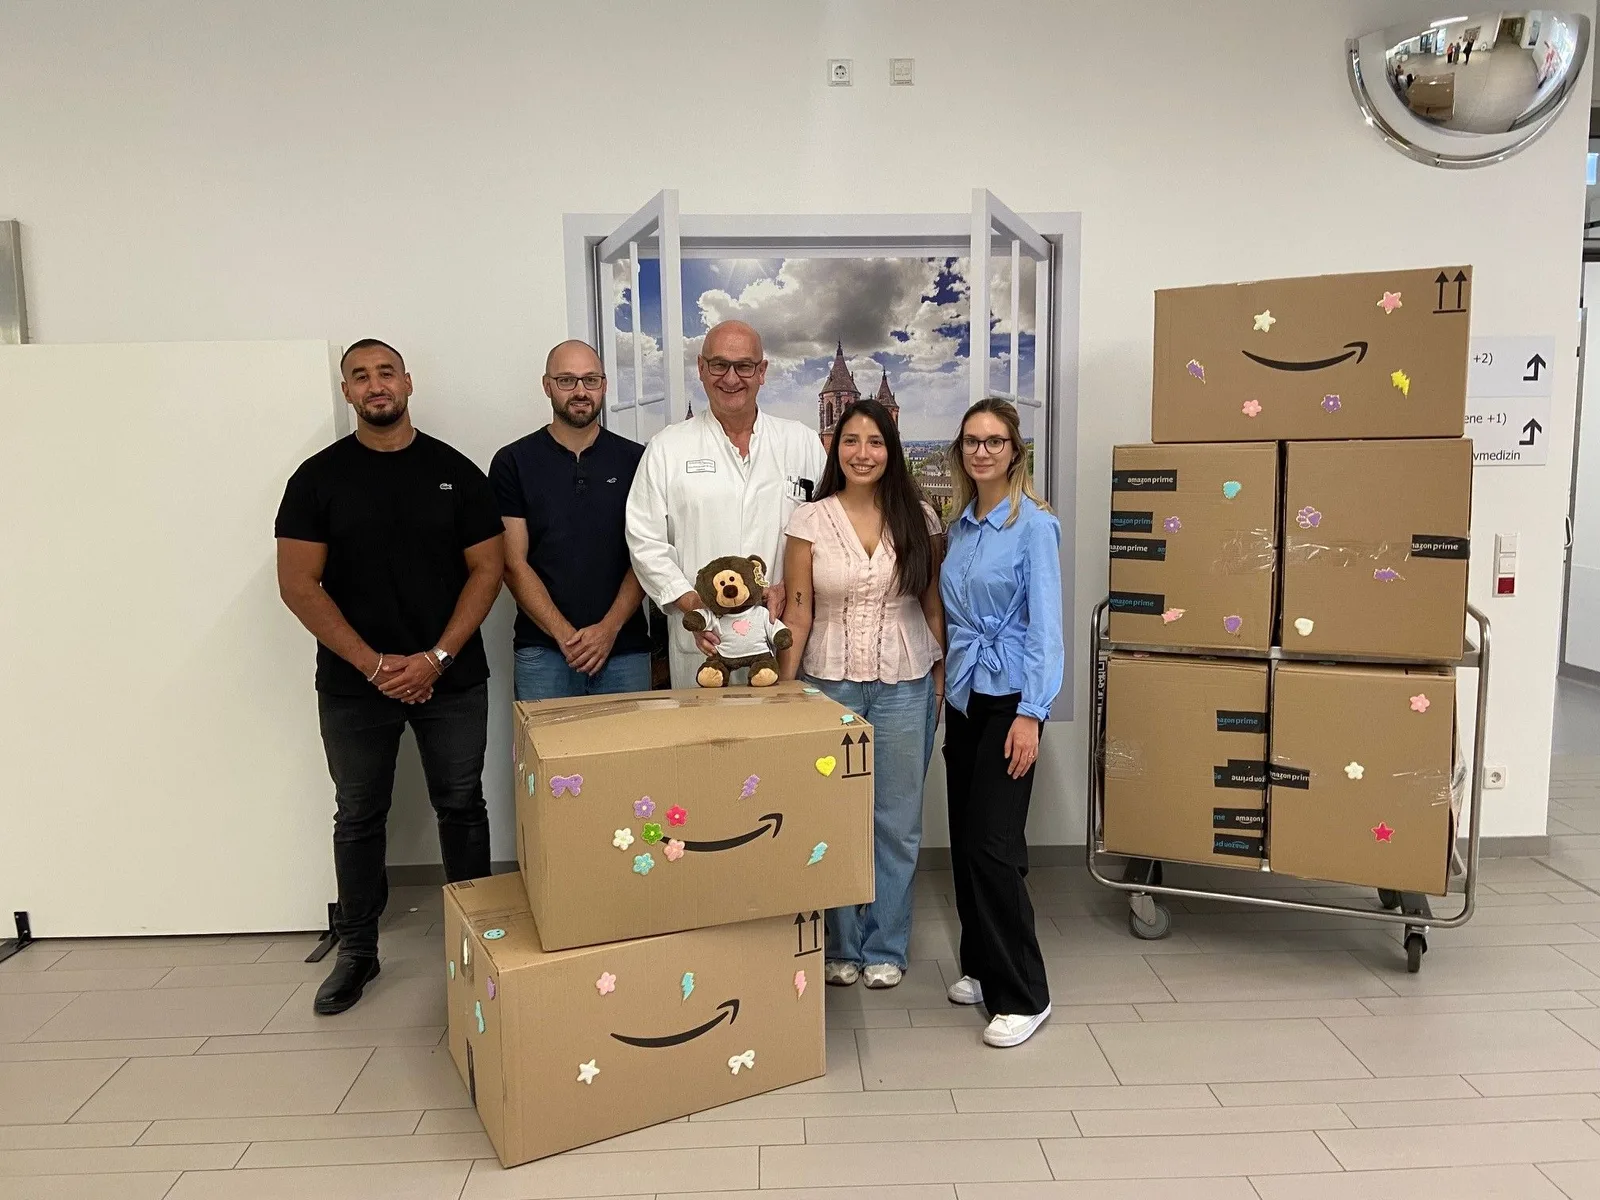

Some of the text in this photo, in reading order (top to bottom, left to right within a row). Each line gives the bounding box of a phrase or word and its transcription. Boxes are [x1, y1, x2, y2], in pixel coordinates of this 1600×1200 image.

[1473, 352, 1493, 366] +2)
[1487, 412, 1507, 426] +1)
[1473, 450, 1521, 461] vmedizin
[1235, 815, 1260, 825] amazon
